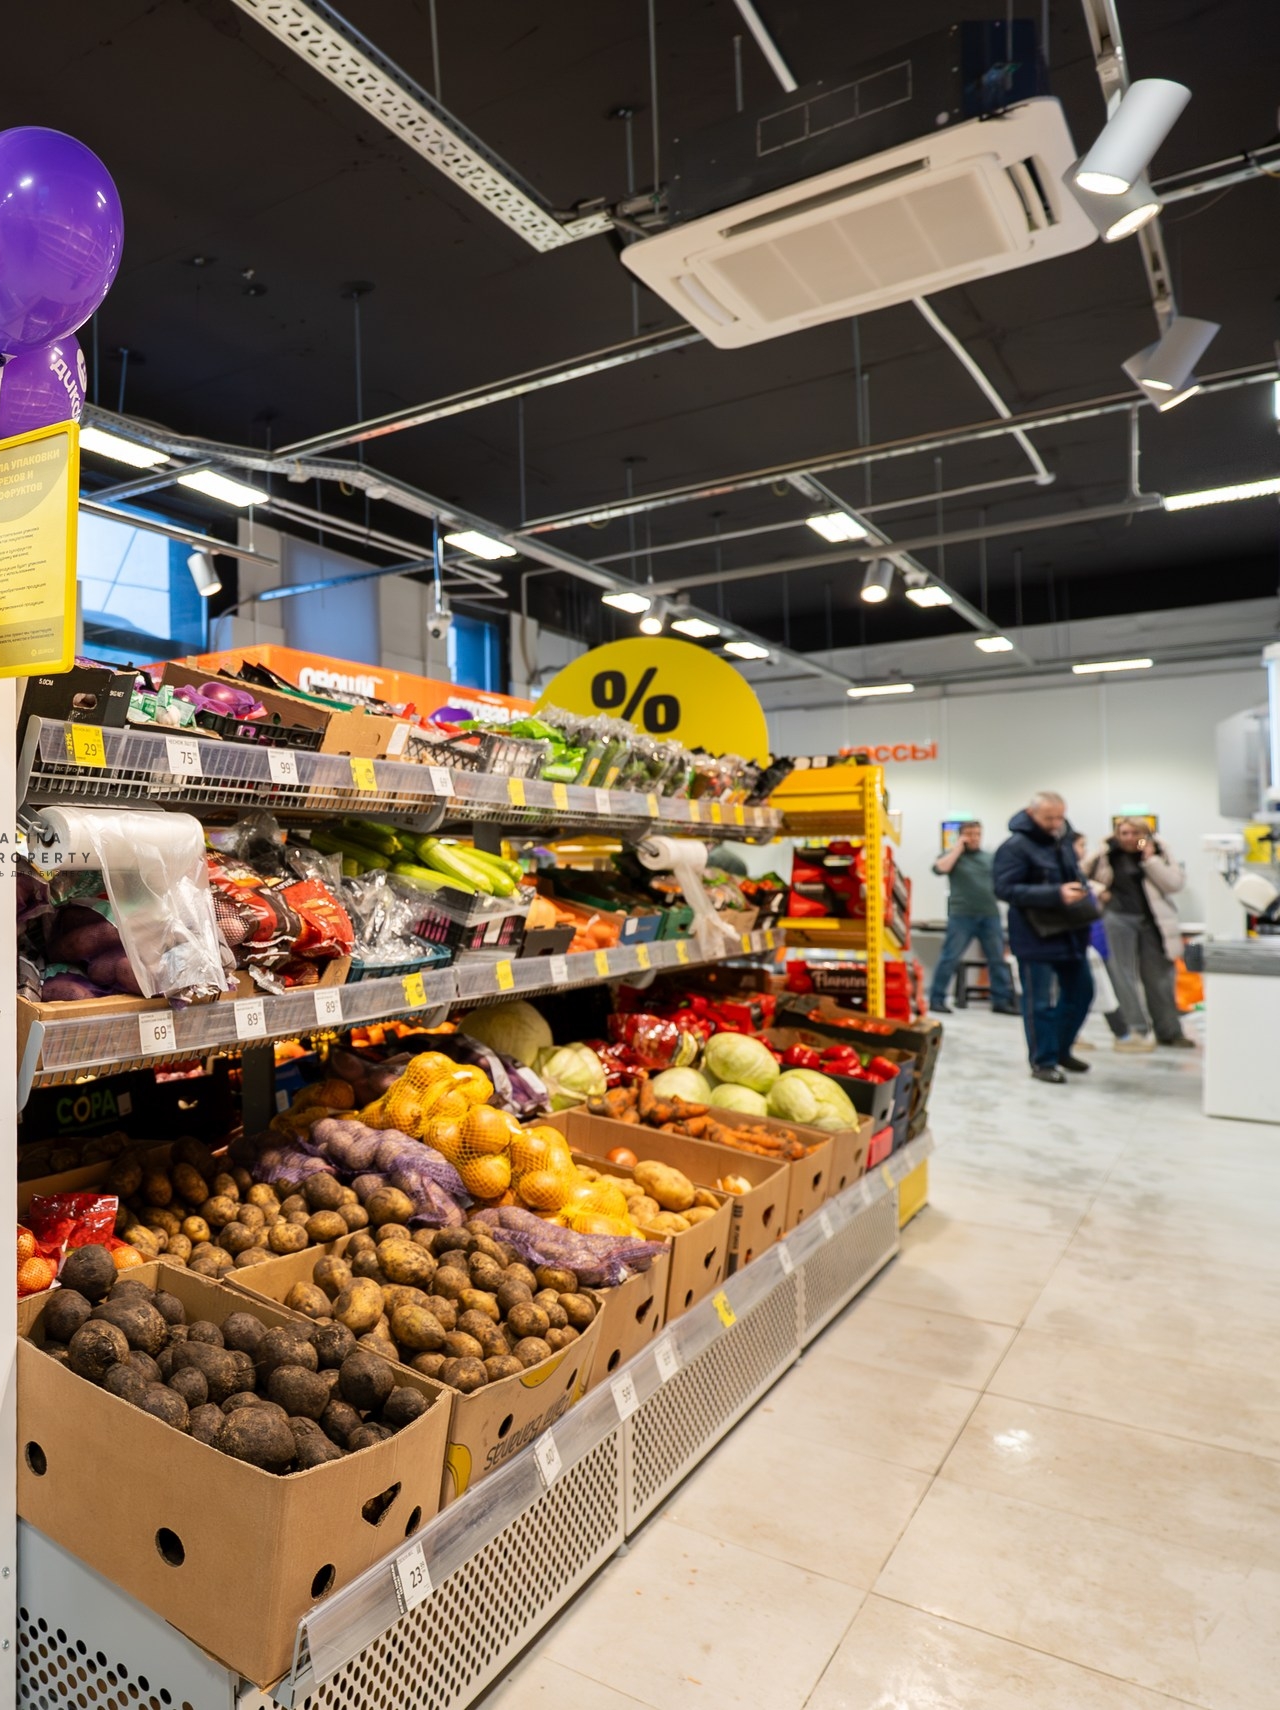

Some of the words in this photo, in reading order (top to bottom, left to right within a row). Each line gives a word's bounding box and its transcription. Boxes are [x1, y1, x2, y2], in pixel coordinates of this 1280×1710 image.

[50, 361, 81, 424] дикс
[11, 449, 60, 470] УПАКОВКИ
[27, 470, 34, 480] И
[591, 667, 681, 735] %
[84, 743, 97, 756] 29
[180, 751, 193, 765] 75
[280, 761, 291, 774] 99
[325, 1000, 336, 1013] 89
[247, 1012, 259, 1026] 89
[153, 1025, 167, 1041] 69
[409, 1566, 423, 1589] 23
